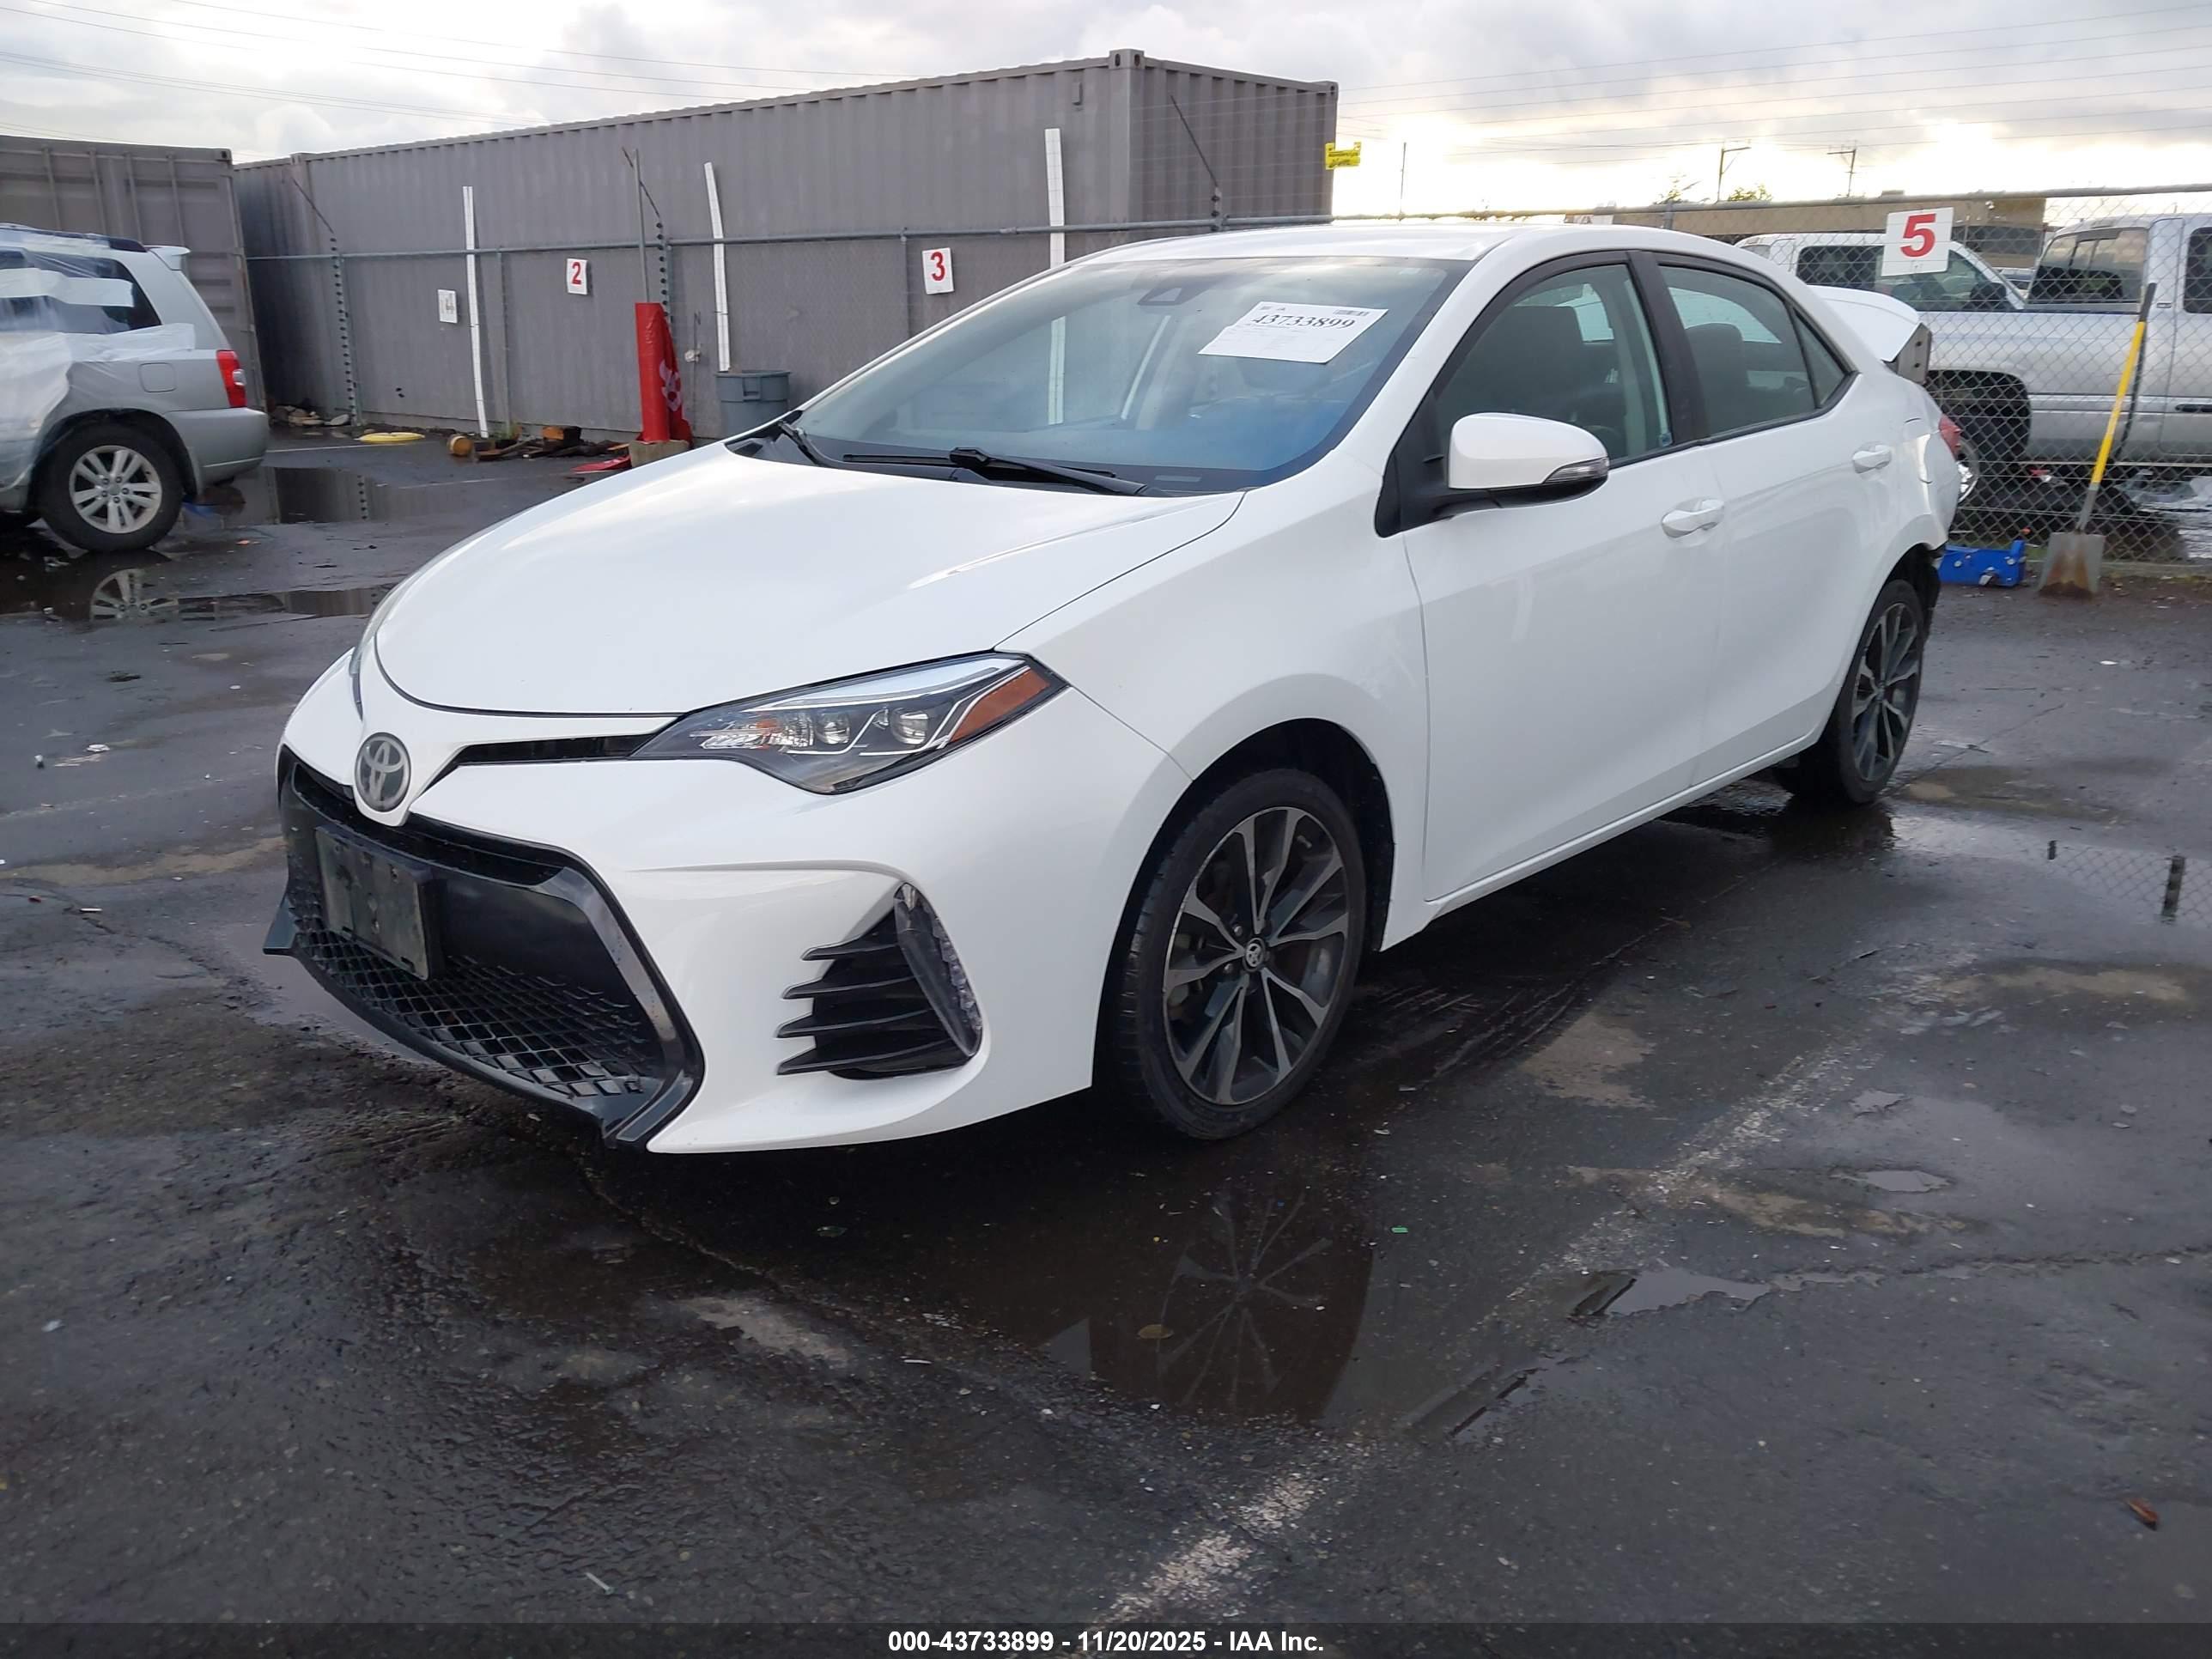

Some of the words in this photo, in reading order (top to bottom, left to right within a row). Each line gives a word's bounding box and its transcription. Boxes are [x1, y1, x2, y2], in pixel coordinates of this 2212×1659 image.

[1900, 213, 1936, 258] 5
[571, 262, 581, 285] 2
[930, 252, 945, 281] 3
[1251, 314, 1356, 329] 43733899
